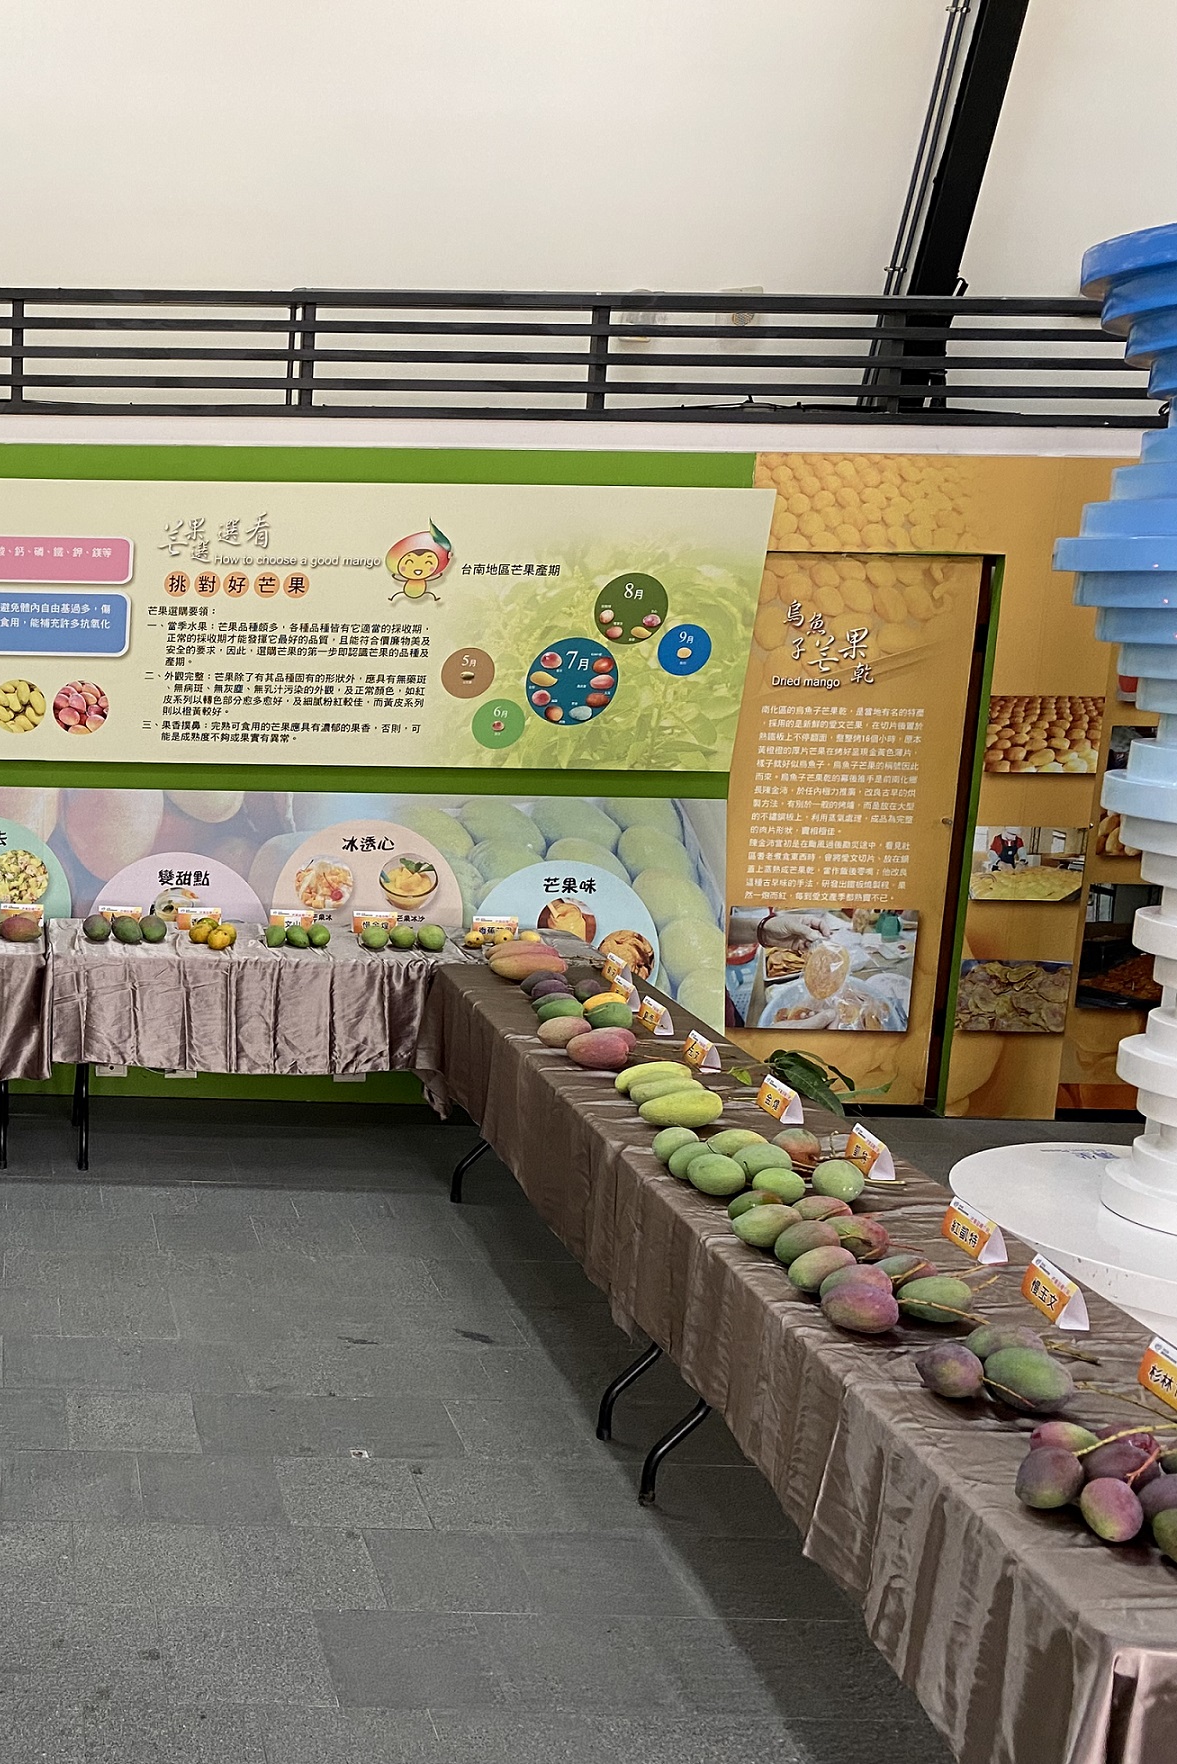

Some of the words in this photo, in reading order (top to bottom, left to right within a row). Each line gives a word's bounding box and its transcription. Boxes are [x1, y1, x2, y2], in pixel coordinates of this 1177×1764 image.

[214, 555, 239, 565] How
[242, 556, 253, 565] to
[256, 555, 298, 566] choose
[301, 558, 308, 566] a
[310, 556, 339, 568] good
[342, 557, 381, 568] mango
[461, 563, 560, 577] 台南地區芒果產期
[168, 575, 306, 594] 挑對好芒果
[624, 583, 644, 600] 8月
[679, 631, 694, 644] 9月
[461, 654, 477, 667] 5月
[566, 651, 589, 671] 7月
[772, 675, 801, 687] Dried
[803, 676, 840, 690] mango
[493, 706, 508, 718] 6月
[342, 835, 395, 852] 冰透心
[157, 868, 210, 887] 變甜點
[543, 877, 597, 895] 芒果味
[951, 1220, 979, 1248] 紅凱特
[1149, 1365, 1177, 1397] 杉林
